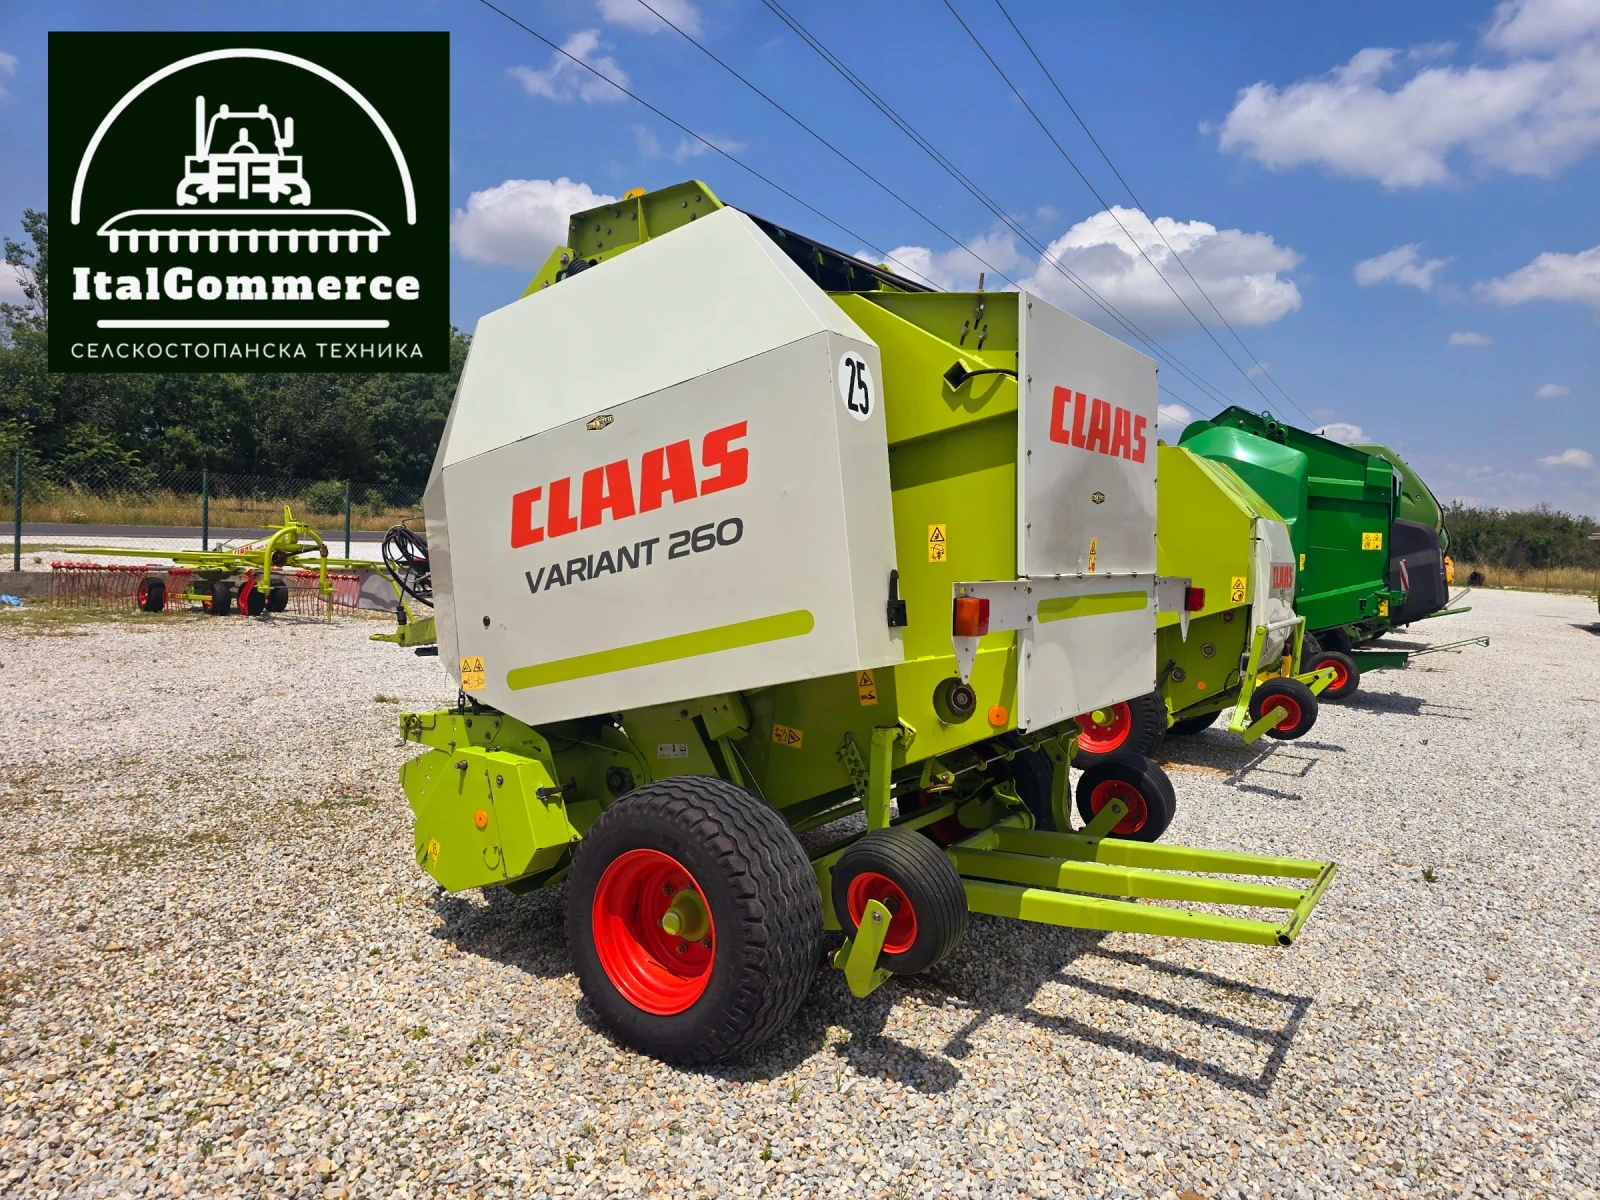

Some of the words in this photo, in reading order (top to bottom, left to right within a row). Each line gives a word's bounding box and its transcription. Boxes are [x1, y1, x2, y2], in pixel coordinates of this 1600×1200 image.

[845, 357, 870, 415] 25
[1049, 386, 1147, 463] CLAAS
[511, 420, 749, 549] CLAAS
[525, 537, 660, 594] VARIANT
[668, 517, 744, 560] 260
[1272, 566, 1293, 588] CLAAS
